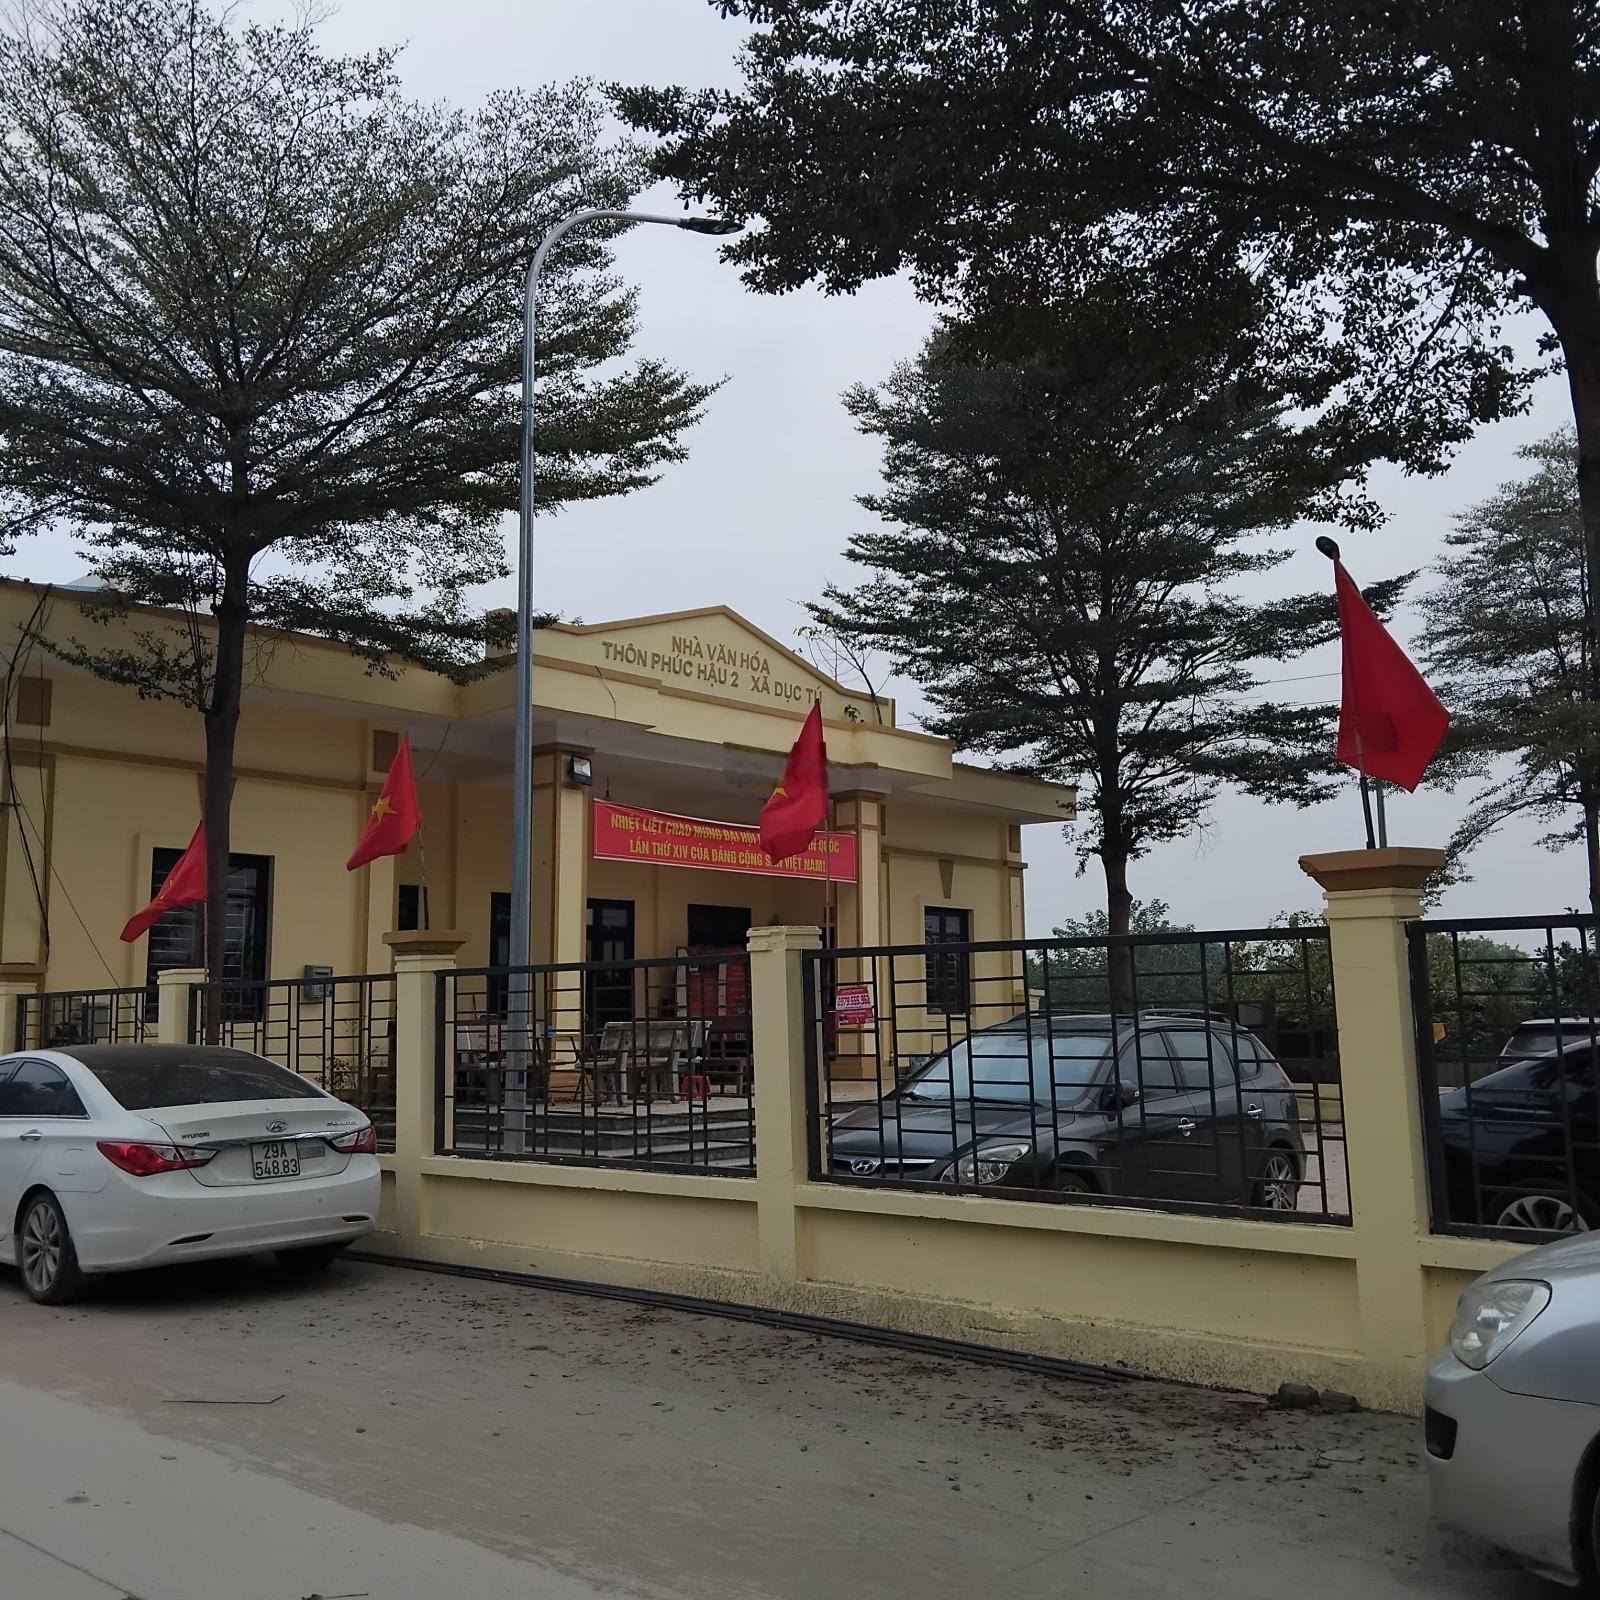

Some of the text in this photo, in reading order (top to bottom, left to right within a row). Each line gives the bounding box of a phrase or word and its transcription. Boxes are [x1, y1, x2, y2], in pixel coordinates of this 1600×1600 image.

[671, 636, 770, 675] NHÀ VĂN HÓA
[601, 640, 822, 704] THÔN PHÚC HẬU 2 XÃ DỤC TÚ
[611, 813, 640, 833] NHIỆT
[642, 817, 664, 835] LIỆT
[723, 829, 739, 845] ĐẠI
[629, 836, 649, 854] LẦN
[652, 840, 671, 856] THỨ
[673, 844, 688, 858] XIV
[690, 842, 709, 861] CỦA
[711, 845, 737, 864] ĐẢNG
[739, 850, 763, 867] CỘNG
[784, 854, 802, 873] VIỆT
[804, 858, 826, 873] NAM!
[181, 1131, 210, 1139] HYUNDAI
[263, 1143, 288, 1160] 29A
[255, 1160, 298, 1177] 548.83
